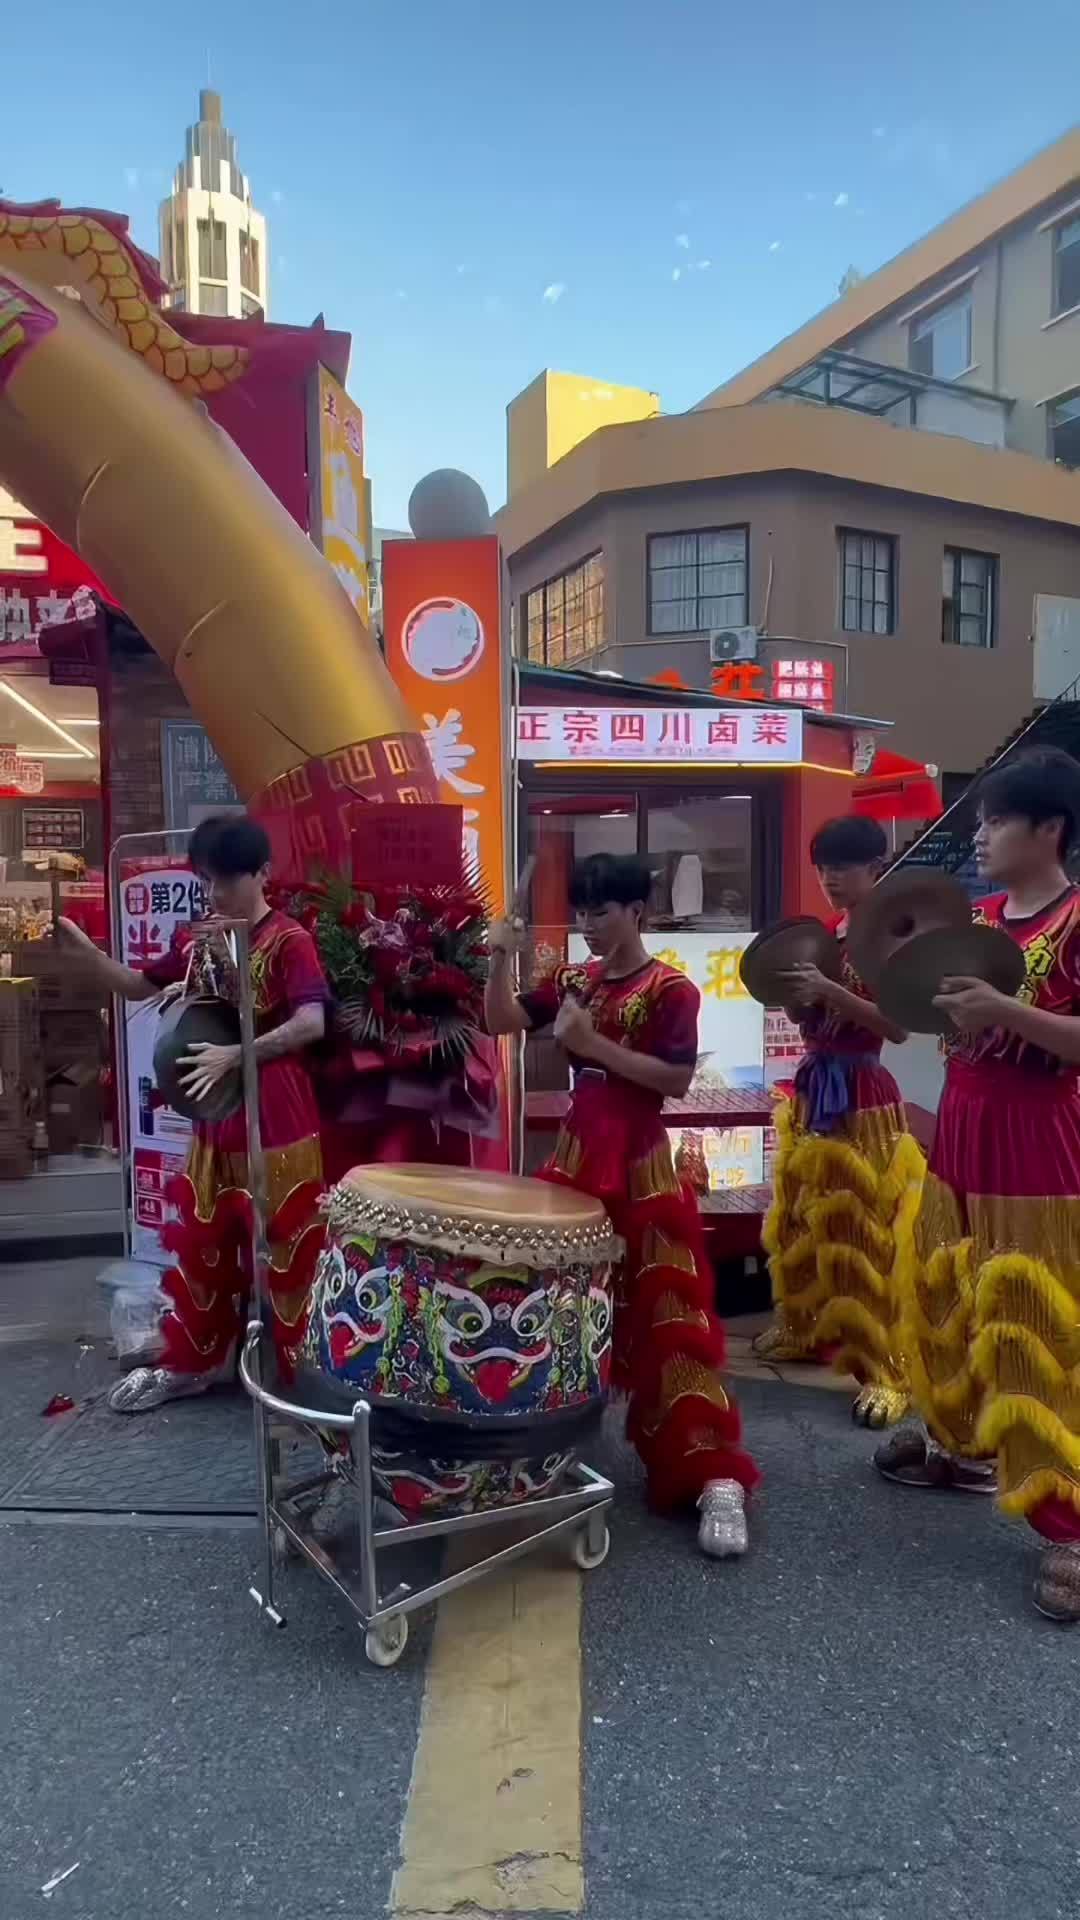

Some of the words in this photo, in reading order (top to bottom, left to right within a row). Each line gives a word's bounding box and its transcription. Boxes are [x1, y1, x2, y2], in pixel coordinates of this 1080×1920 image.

[517, 710, 788, 745] 正宗四川卤菜
